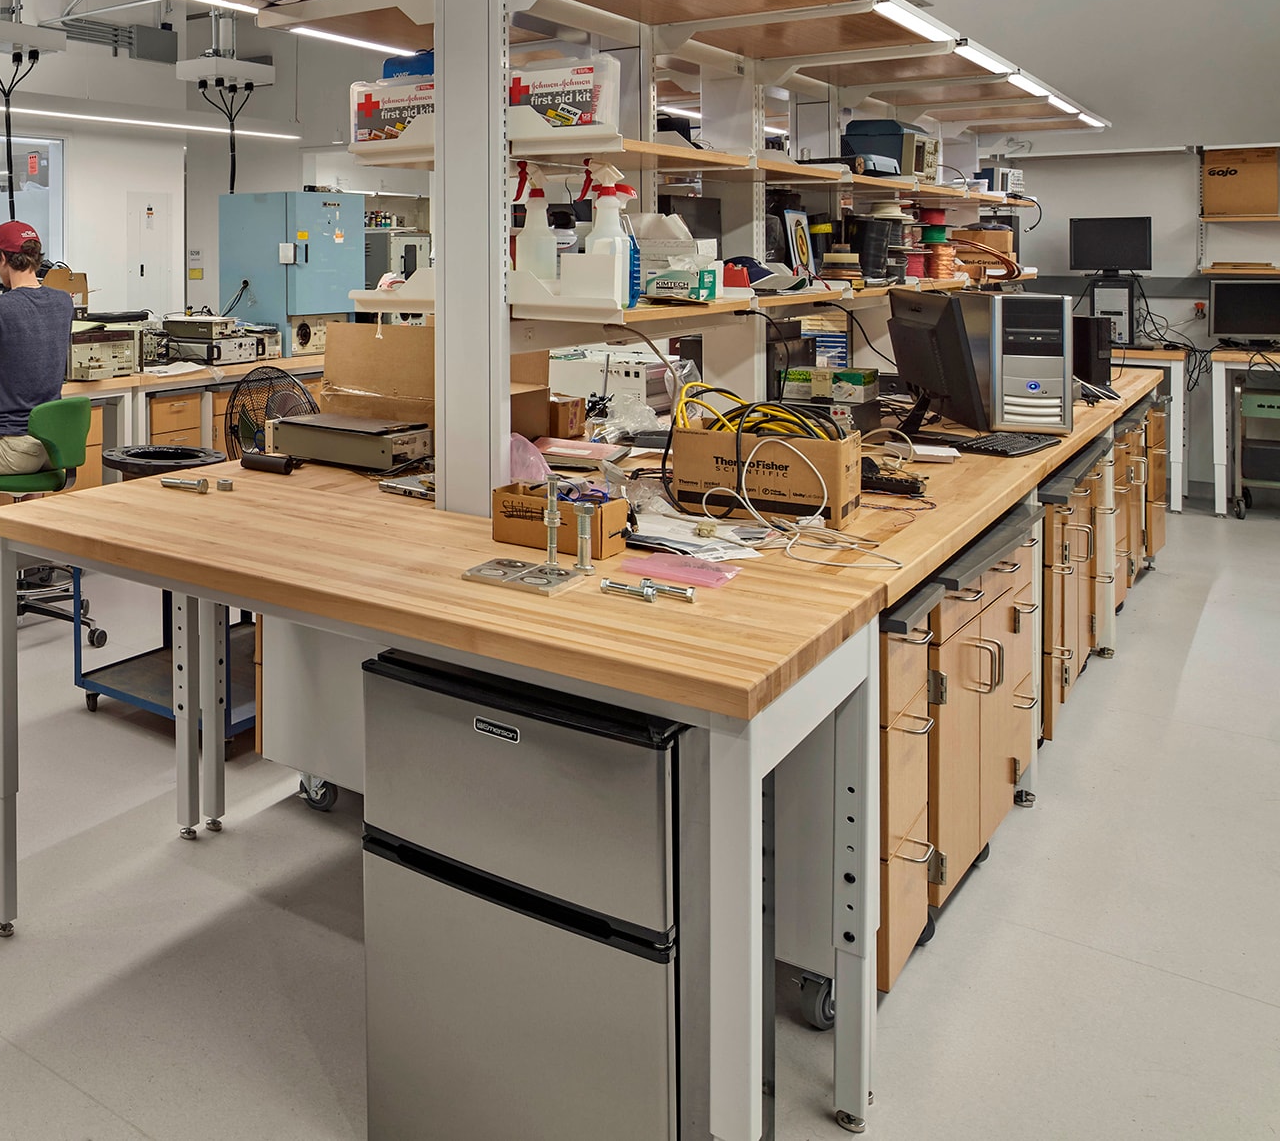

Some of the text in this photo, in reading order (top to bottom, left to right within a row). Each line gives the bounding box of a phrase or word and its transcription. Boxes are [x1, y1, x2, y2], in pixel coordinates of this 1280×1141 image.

[531, 91, 591, 106] first aid kit
[381, 106, 433, 119] first aid kit
[715, 466, 788, 478] SCINTIFIC
